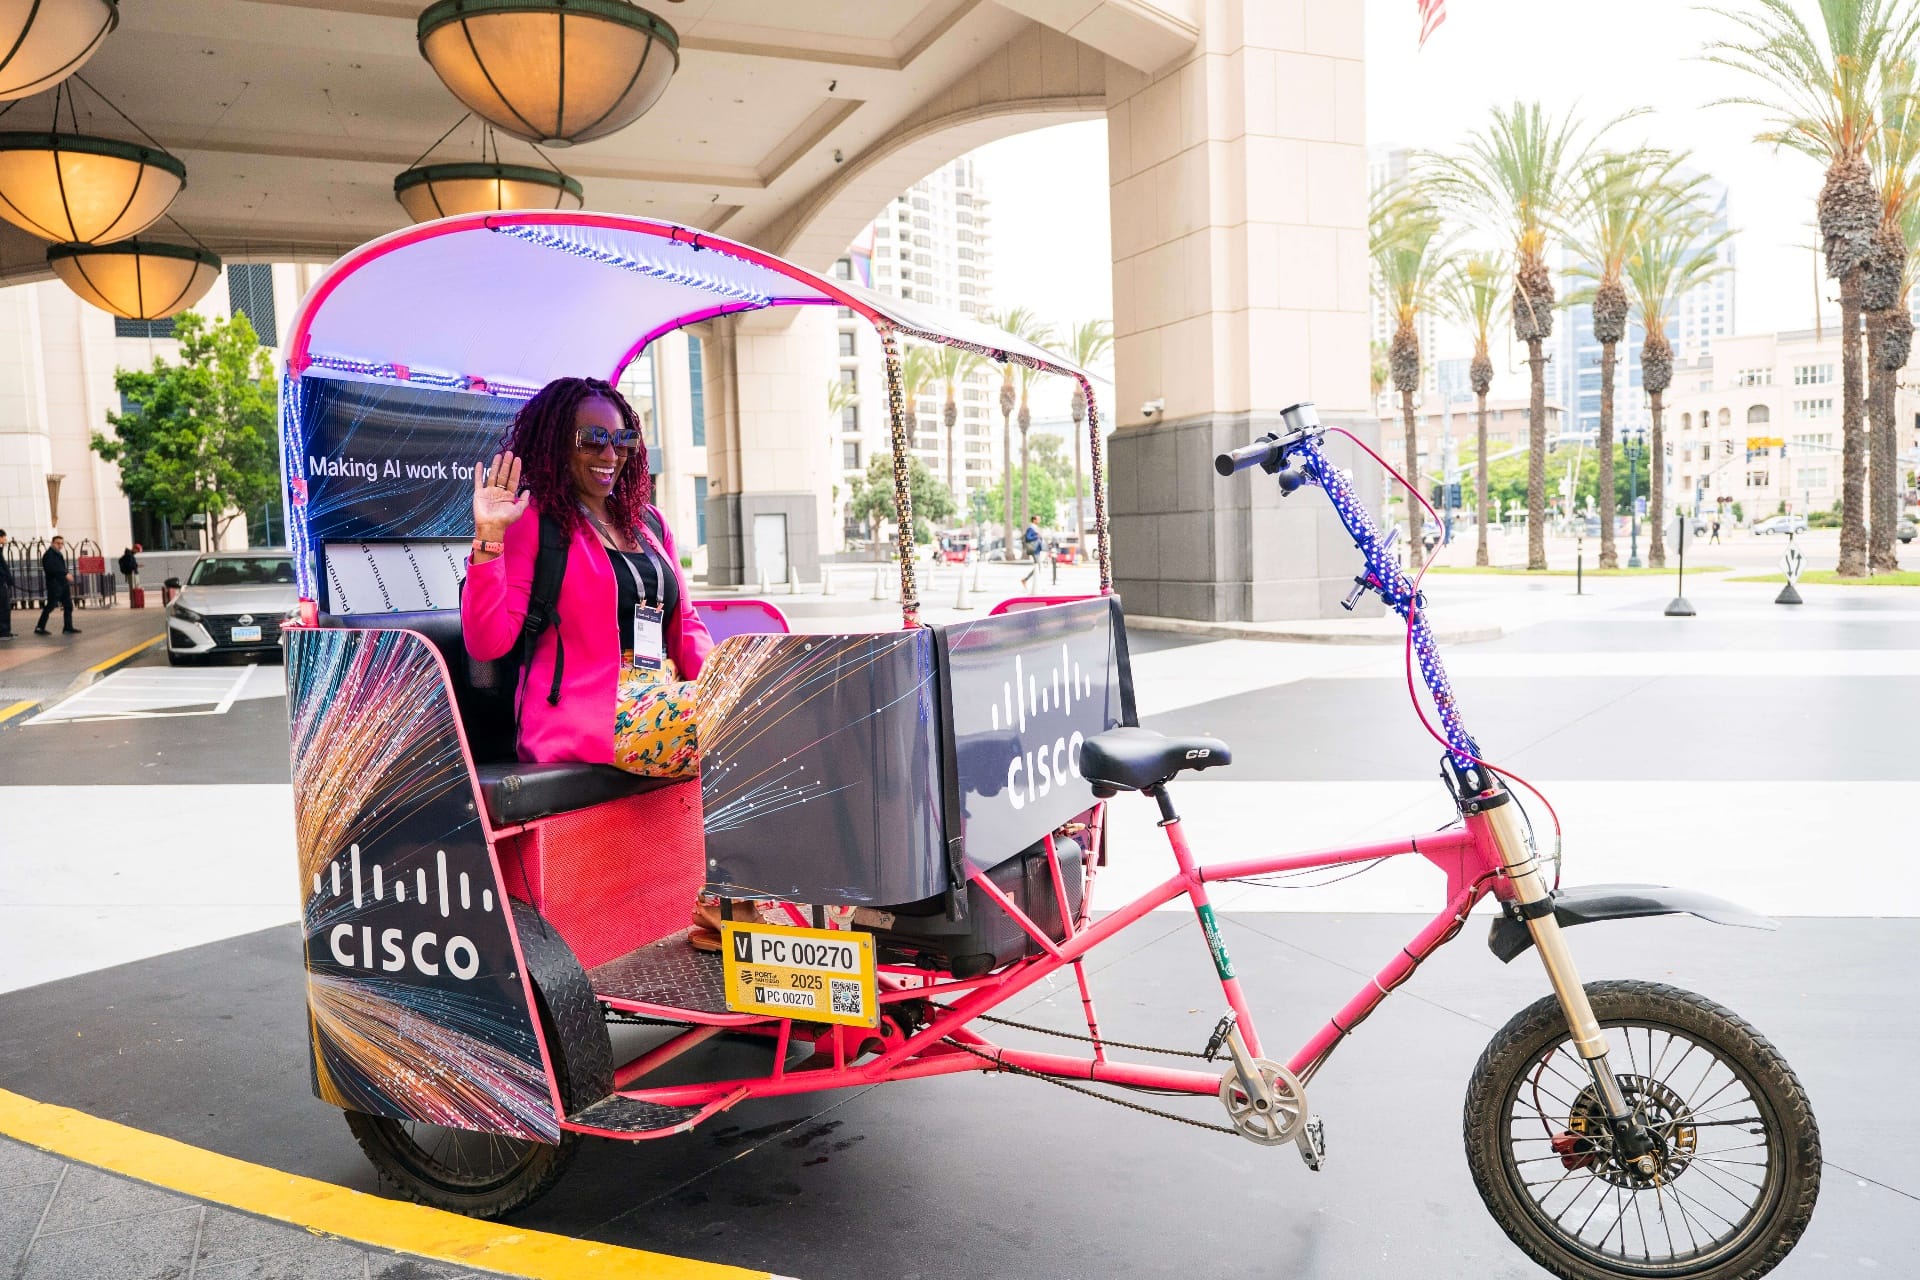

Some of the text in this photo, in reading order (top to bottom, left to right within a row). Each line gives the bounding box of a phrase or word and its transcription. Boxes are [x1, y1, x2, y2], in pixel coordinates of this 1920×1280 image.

[309, 456, 378, 482] Making
[383, 459, 400, 478] AI
[405, 461, 448, 480] work
[452, 461, 473, 480] for
[367, 554, 393, 610] Piedmont
[408, 554, 433, 608] Piedmont
[1007, 730, 1084, 810] CISCO
[330, 923, 480, 981] CISCO
[735, 936, 853, 970] V PC 00270
[755, 989, 814, 1006] V PC 00270
[790, 973, 823, 990] 2025
